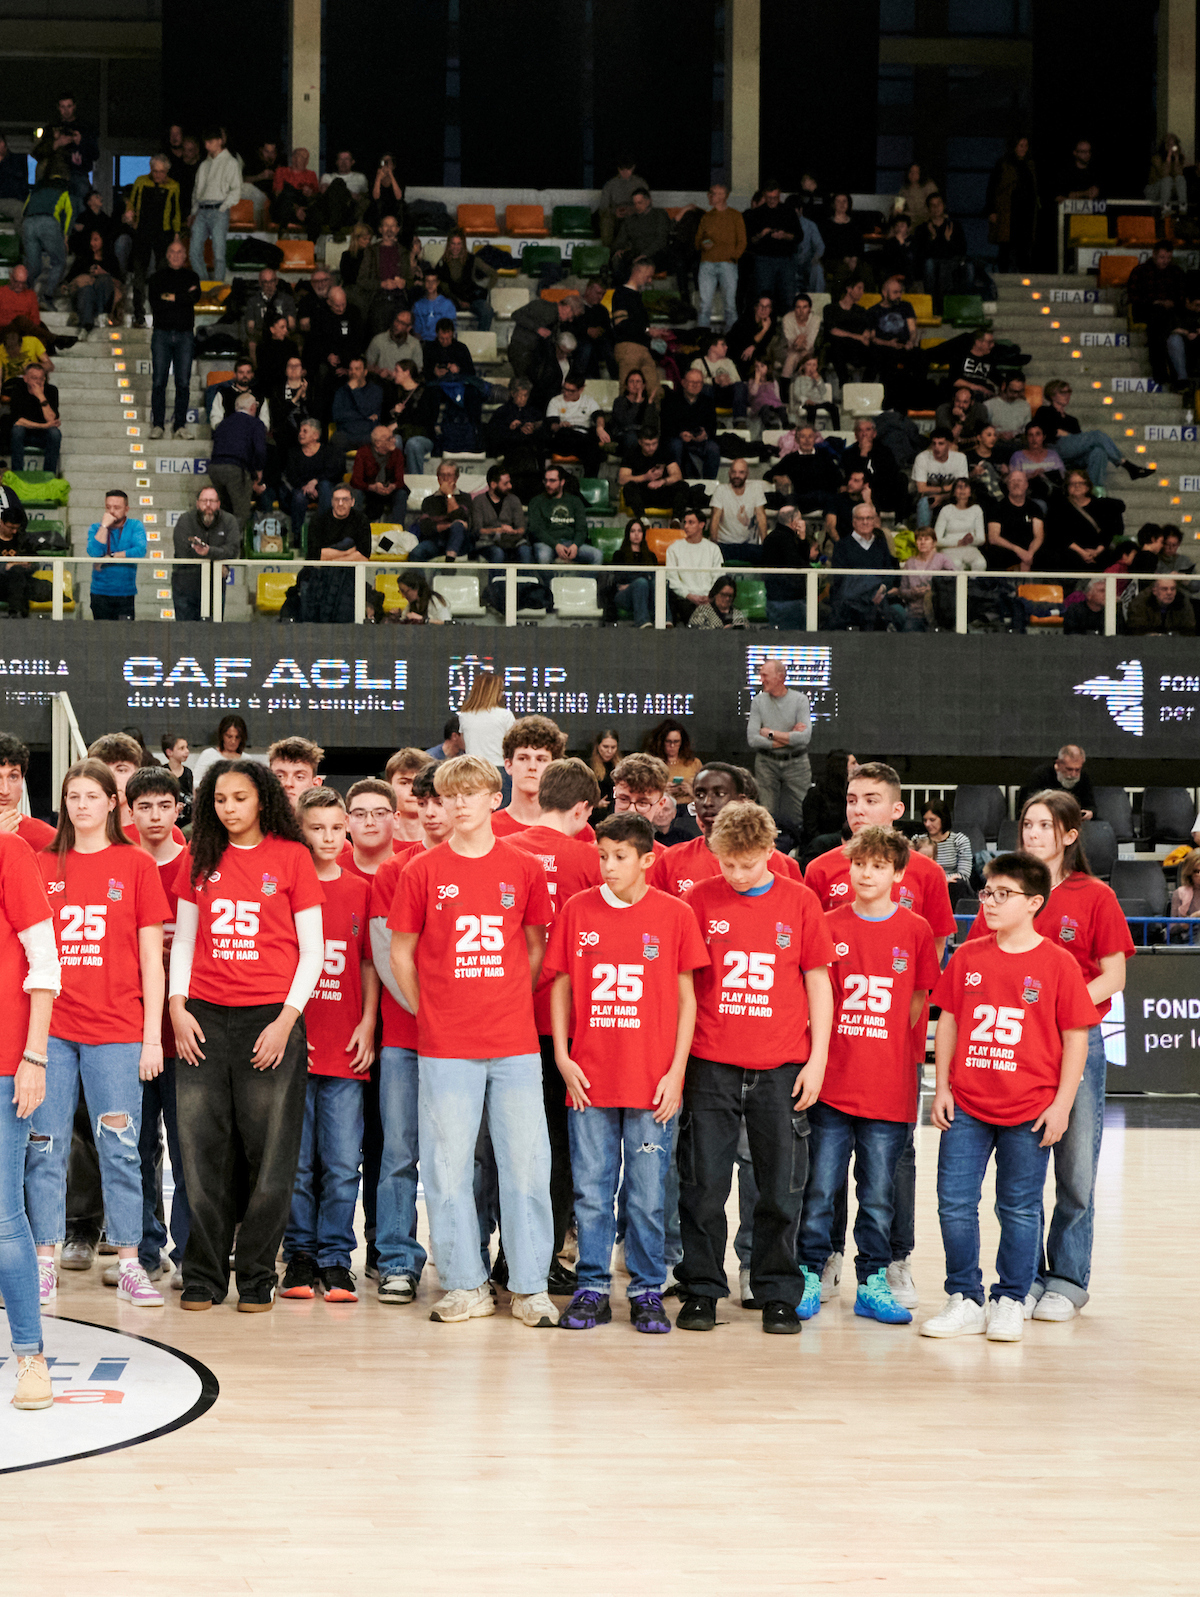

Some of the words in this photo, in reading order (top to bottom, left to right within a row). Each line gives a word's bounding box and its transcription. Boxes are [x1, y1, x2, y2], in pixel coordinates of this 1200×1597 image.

[1054, 292, 1084, 302] FILA
[1084, 334, 1115, 346] FILA
[1115, 379, 1145, 391] FILA
[1149, 427, 1178, 439] FILA
[1184, 427, 1195, 440] 6
[160, 460, 191, 473] FILA
[196, 460, 207, 473] 5
[123, 656, 252, 687] CAF
[262, 658, 408, 689] ACLI
[504, 667, 567, 687] FIP
[595, 692, 638, 715] ALTO
[59, 905, 107, 941] 25
[211, 898, 261, 937] 25
[455, 914, 505, 953] 25
[61, 944, 80, 955] PLAY
[81, 944, 101, 954] HARD
[212, 938, 231, 949] PLAY
[232, 939, 255, 949] HARD
[60, 956, 82, 967] STUDY
[83, 956, 103, 966] HARD
[236, 950, 259, 960] HARD
[456, 955, 478, 967] PLAY
[480, 955, 502, 967] HARD
[454, 968, 482, 979] STUDY
[484, 967, 504, 978] HARD
[722, 950, 776, 991] 25
[319, 978, 340, 989] HARD
[591, 963, 644, 1001] 25
[323, 991, 342, 1001] HARD
[721, 992, 743, 1004] PLAY
[744, 993, 769, 1005] HARD
[842, 974, 894, 1013] 25
[591, 1005, 612, 1016] PLAY
[614, 1005, 638, 1016] HARD
[718, 1004, 747, 1016] STUDY
[748, 1005, 773, 1017] HARD
[589, 1016, 616, 1028] STUDY
[617, 1017, 641, 1028] HARD
[841, 1013, 861, 1026] PLAY
[863, 1015, 886, 1027] HARD
[970, 1004, 1025, 1045] 25
[837, 1025, 865, 1038] STUDY
[866, 1027, 888, 1039] HARD
[1145, 1032, 1183, 1053] per
[968, 1045, 988, 1057] PLAY
[990, 1048, 1014, 1060] HARD
[965, 1057, 992, 1069] STUDY
[992, 1059, 1017, 1072] HARD
